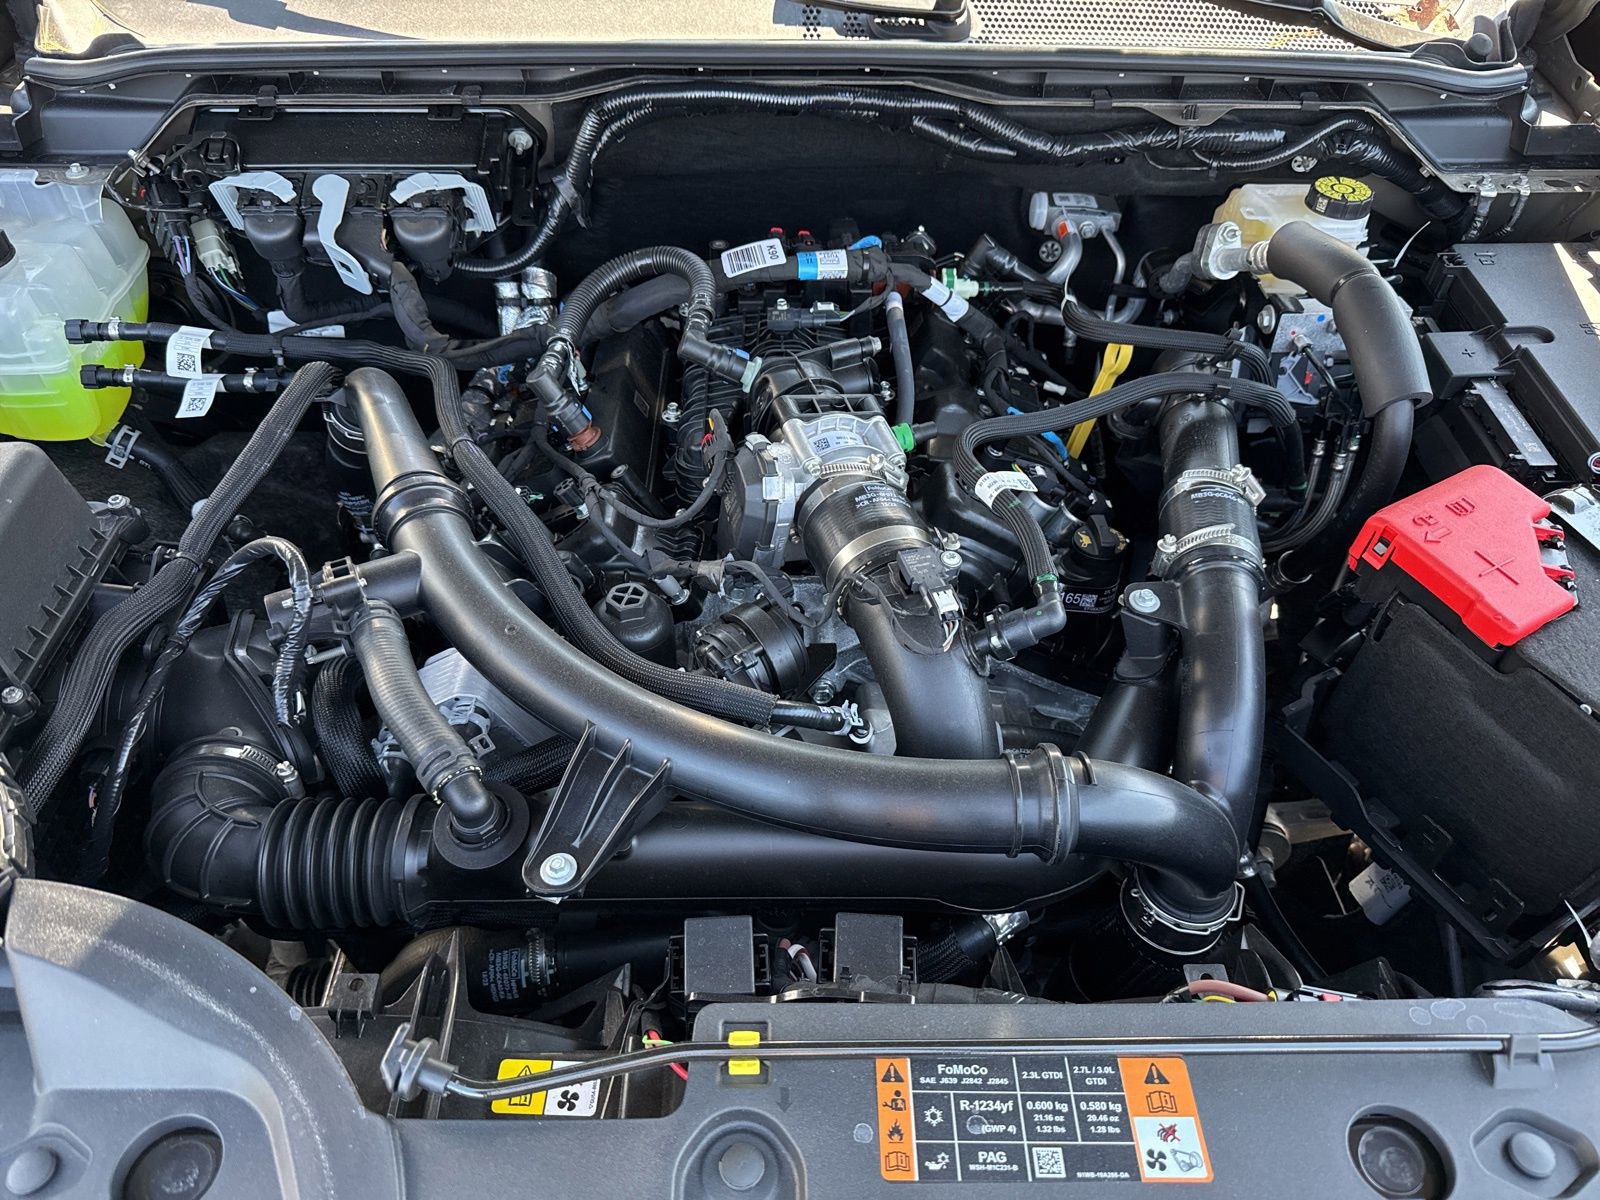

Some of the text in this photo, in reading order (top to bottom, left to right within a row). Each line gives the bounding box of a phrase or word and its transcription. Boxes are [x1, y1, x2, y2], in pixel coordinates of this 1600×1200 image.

[767, 245, 780, 260] K90
[937, 1064, 988, 1075] FoMoCo
[1022, 1071, 1040, 1079] 2.3L
[1073, 1066, 1091, 1074] 2.7L
[1085, 1077, 1107, 1085] GTDI
[960, 1100, 1014, 1114] R-1234yf
[1026, 1101, 1068, 1112] 0.600 kg
[1080, 1101, 1122, 1112] 0.580 kg
[981, 1125, 1017, 1134] (GWP 4)
[978, 1152, 1007, 1163] PAG
